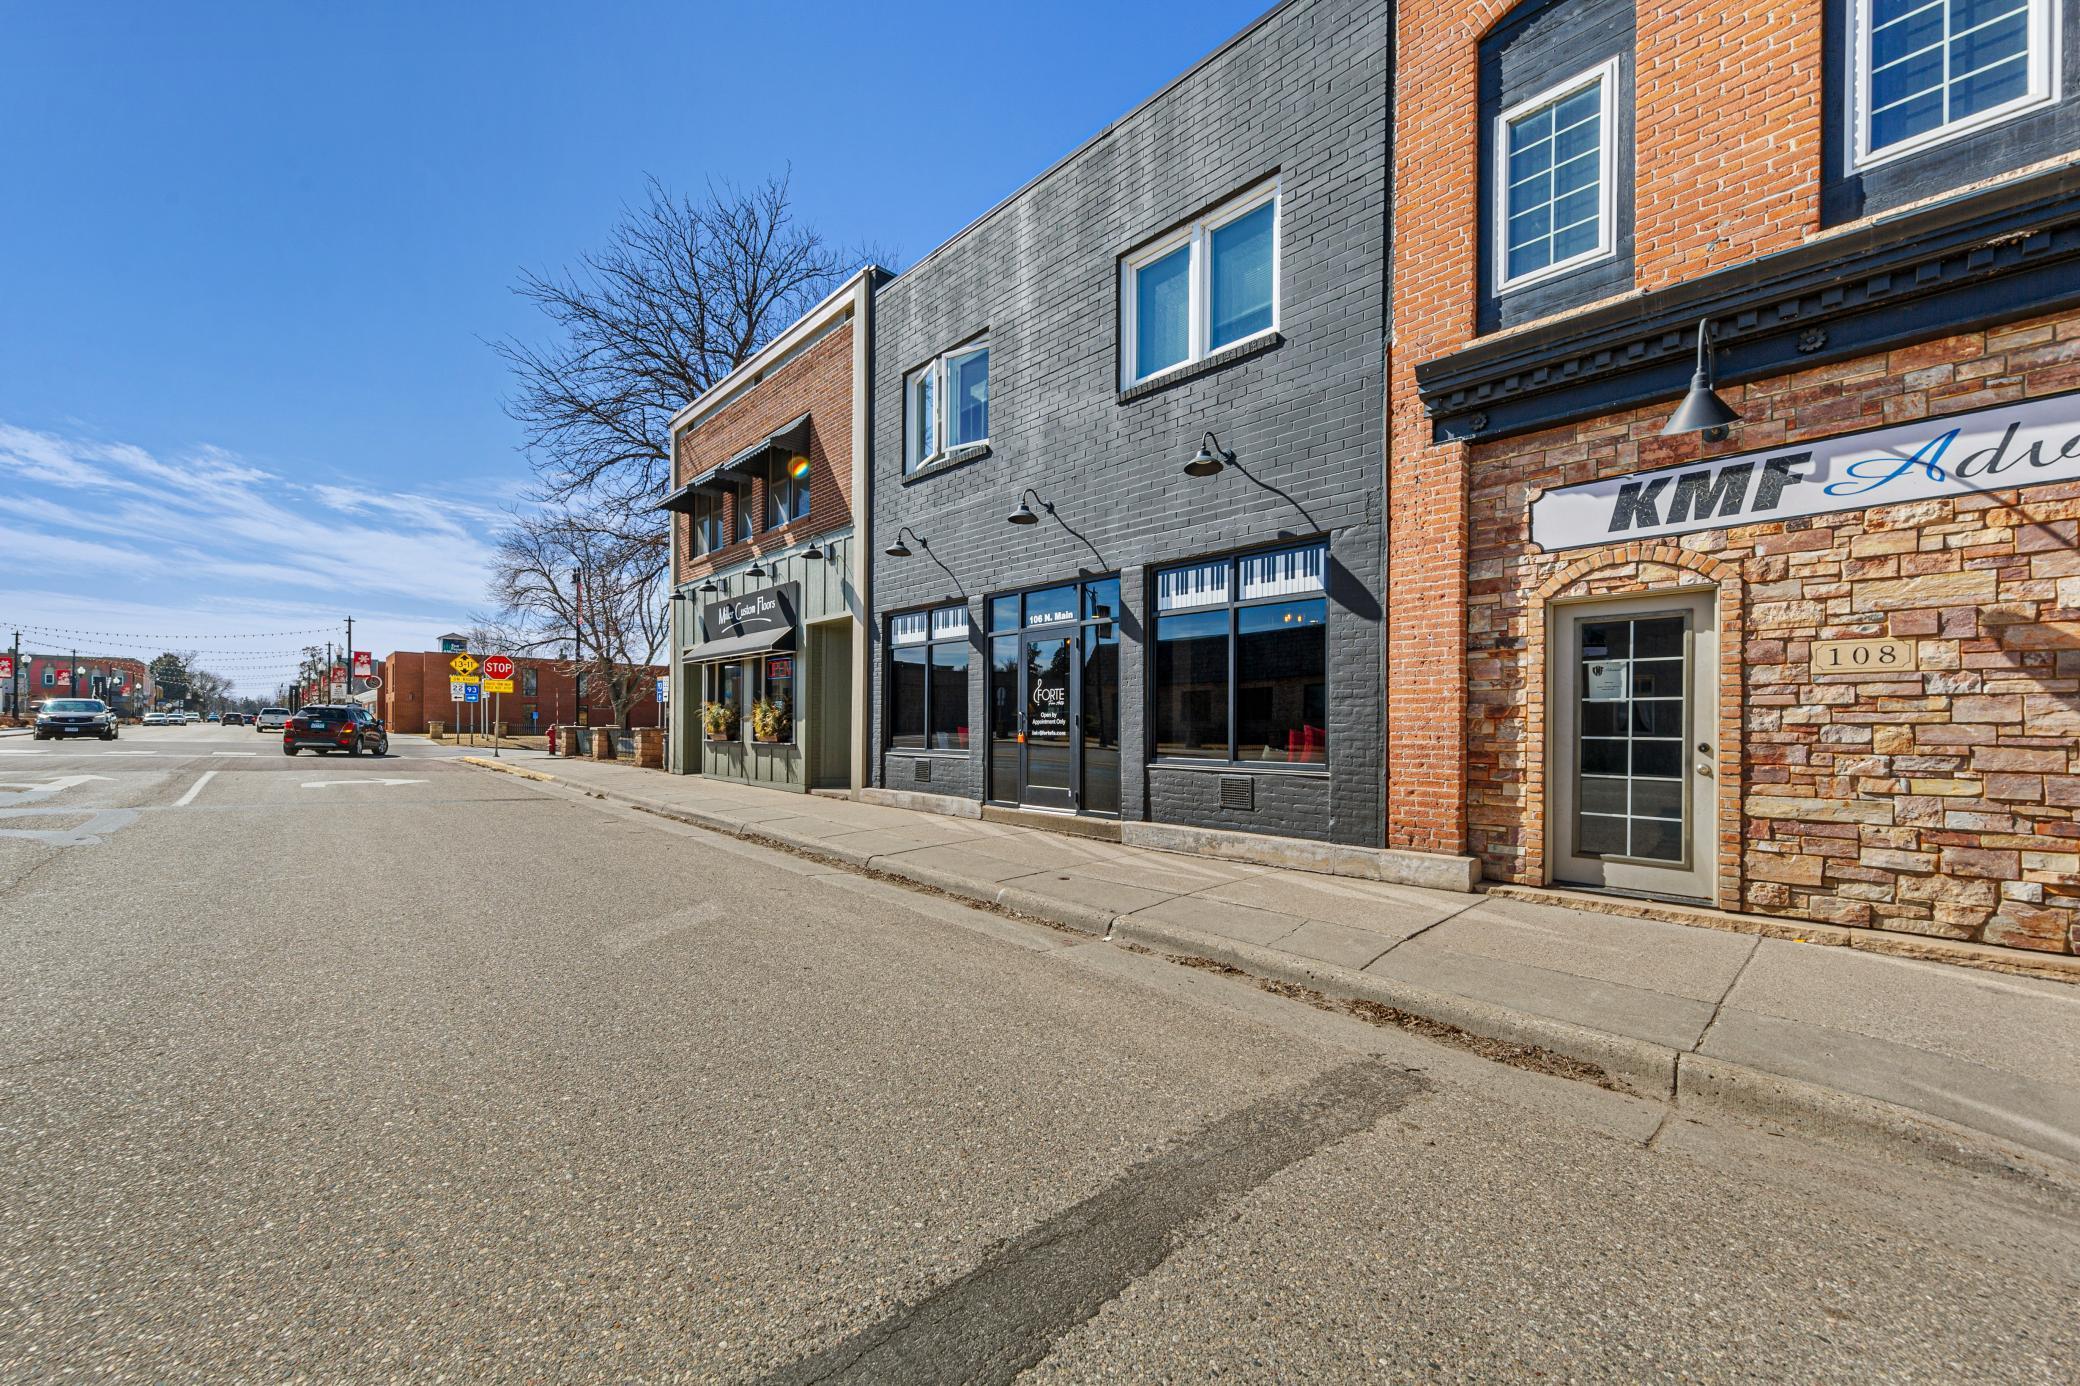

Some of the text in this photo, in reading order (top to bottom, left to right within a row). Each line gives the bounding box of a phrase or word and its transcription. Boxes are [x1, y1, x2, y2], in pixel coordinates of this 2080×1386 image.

[1608, 451, 1812, 532] KMF
[718, 596, 776, 625] Miller Custom Floors
[1029, 610, 1073, 624] 106 N. Main
[1828, 645, 1896, 666] 108
[486, 662, 512, 673] STOP
[1037, 688, 1065, 702] FORTE
[1040, 711, 1052, 719] Open
[1056, 718, 1066, 726] Only
